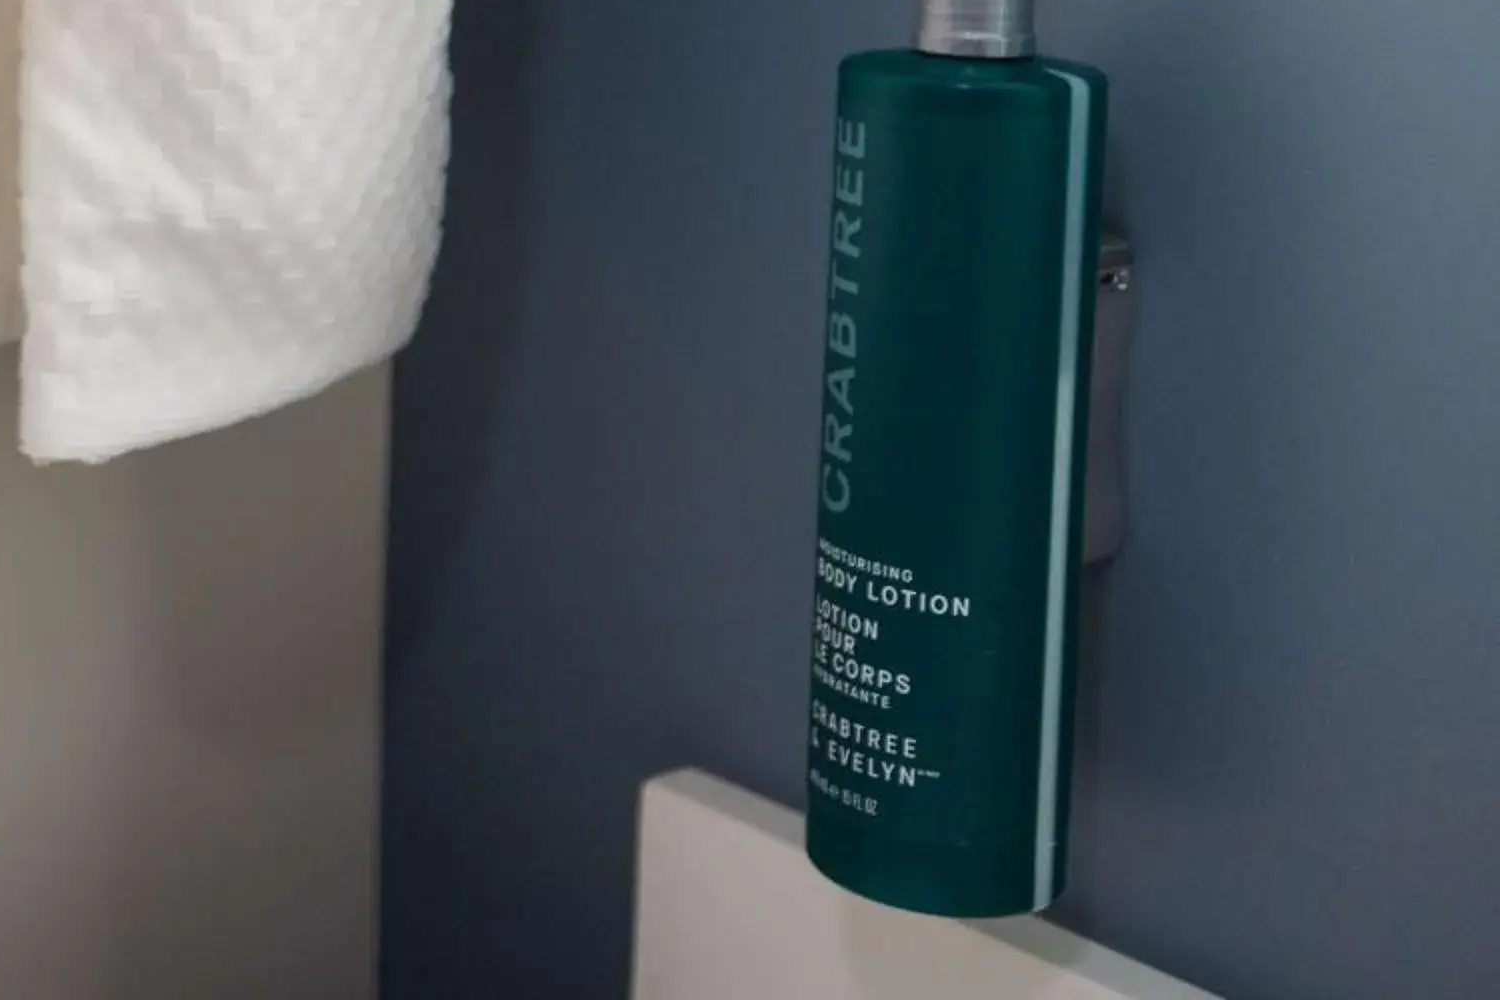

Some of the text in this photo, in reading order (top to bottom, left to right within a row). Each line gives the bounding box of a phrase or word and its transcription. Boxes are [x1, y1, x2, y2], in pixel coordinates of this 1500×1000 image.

[822, 117, 866, 513] CRABTREE
[866, 580, 970, 617] LOTION
[832, 653, 911, 695] CORPS
[827, 739, 916, 787] EVELYN
